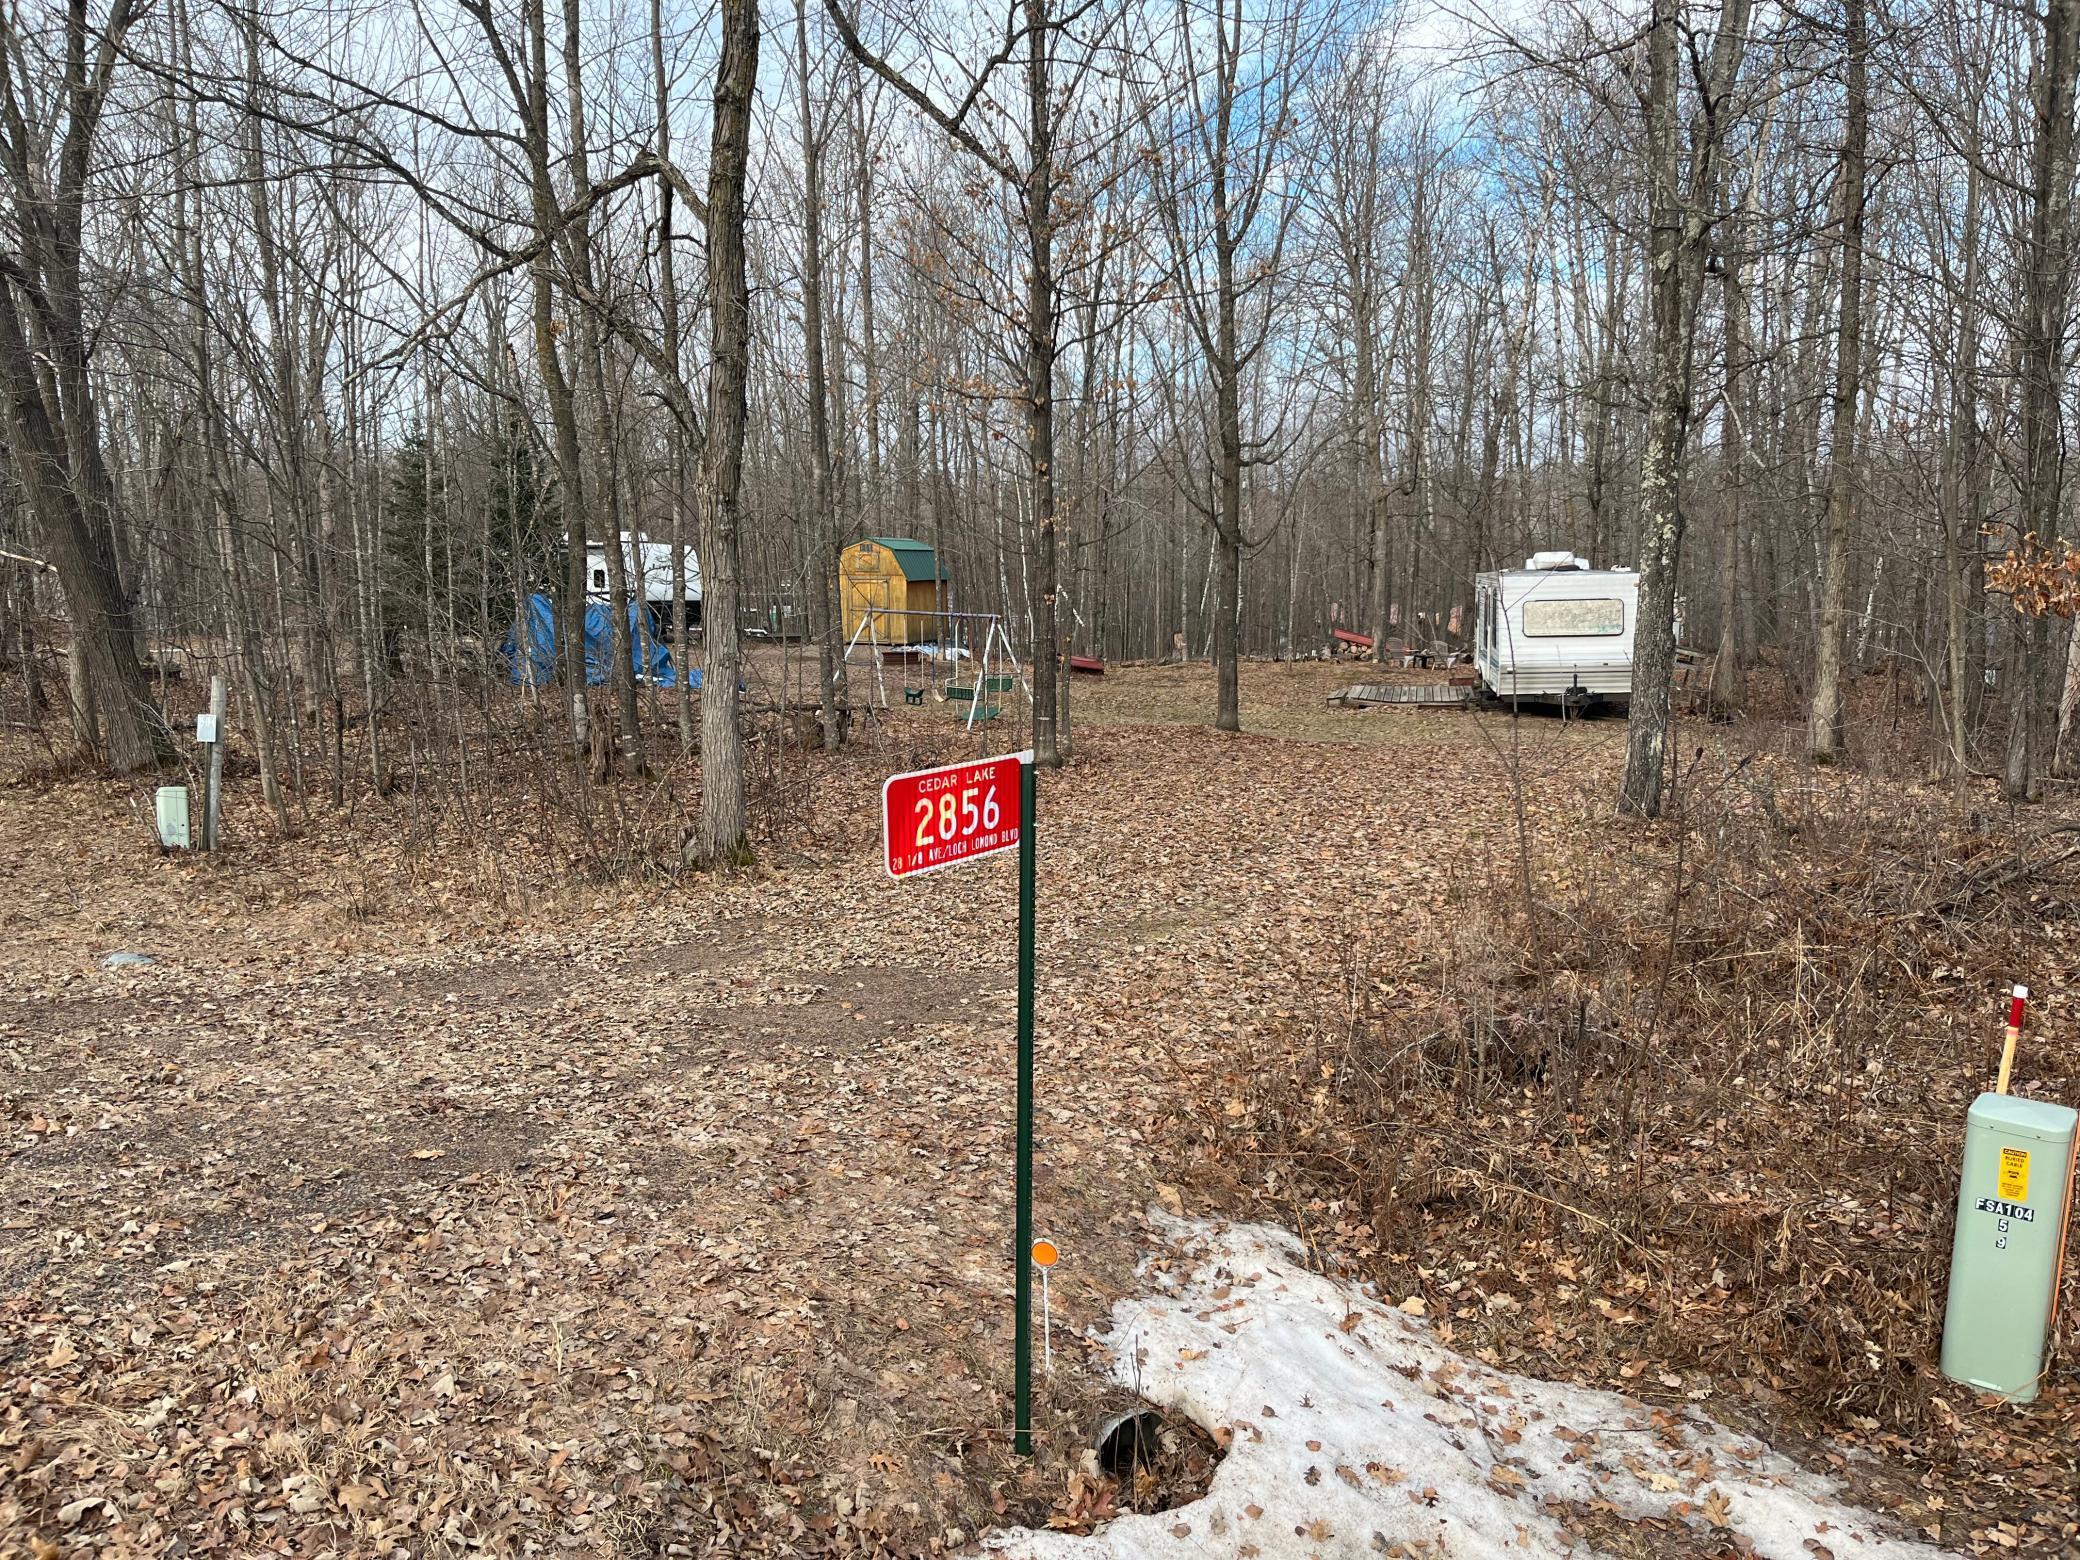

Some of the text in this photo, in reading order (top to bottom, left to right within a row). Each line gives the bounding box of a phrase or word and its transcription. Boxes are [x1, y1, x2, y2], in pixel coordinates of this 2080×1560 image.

[919, 767, 996, 793] CEDAR LAKE
[914, 785, 1000, 846] 2856
[892, 857, 903, 870] 28
[929, 841, 967, 861] AVE/LOCH
[971, 833, 998, 850] LOMOND
[1002, 828, 1019, 843] BLVD
[1976, 1198, 2033, 1221] FSA104
[1999, 1220, 2008, 1231] 5
[1997, 1237, 2005, 1247] 9
